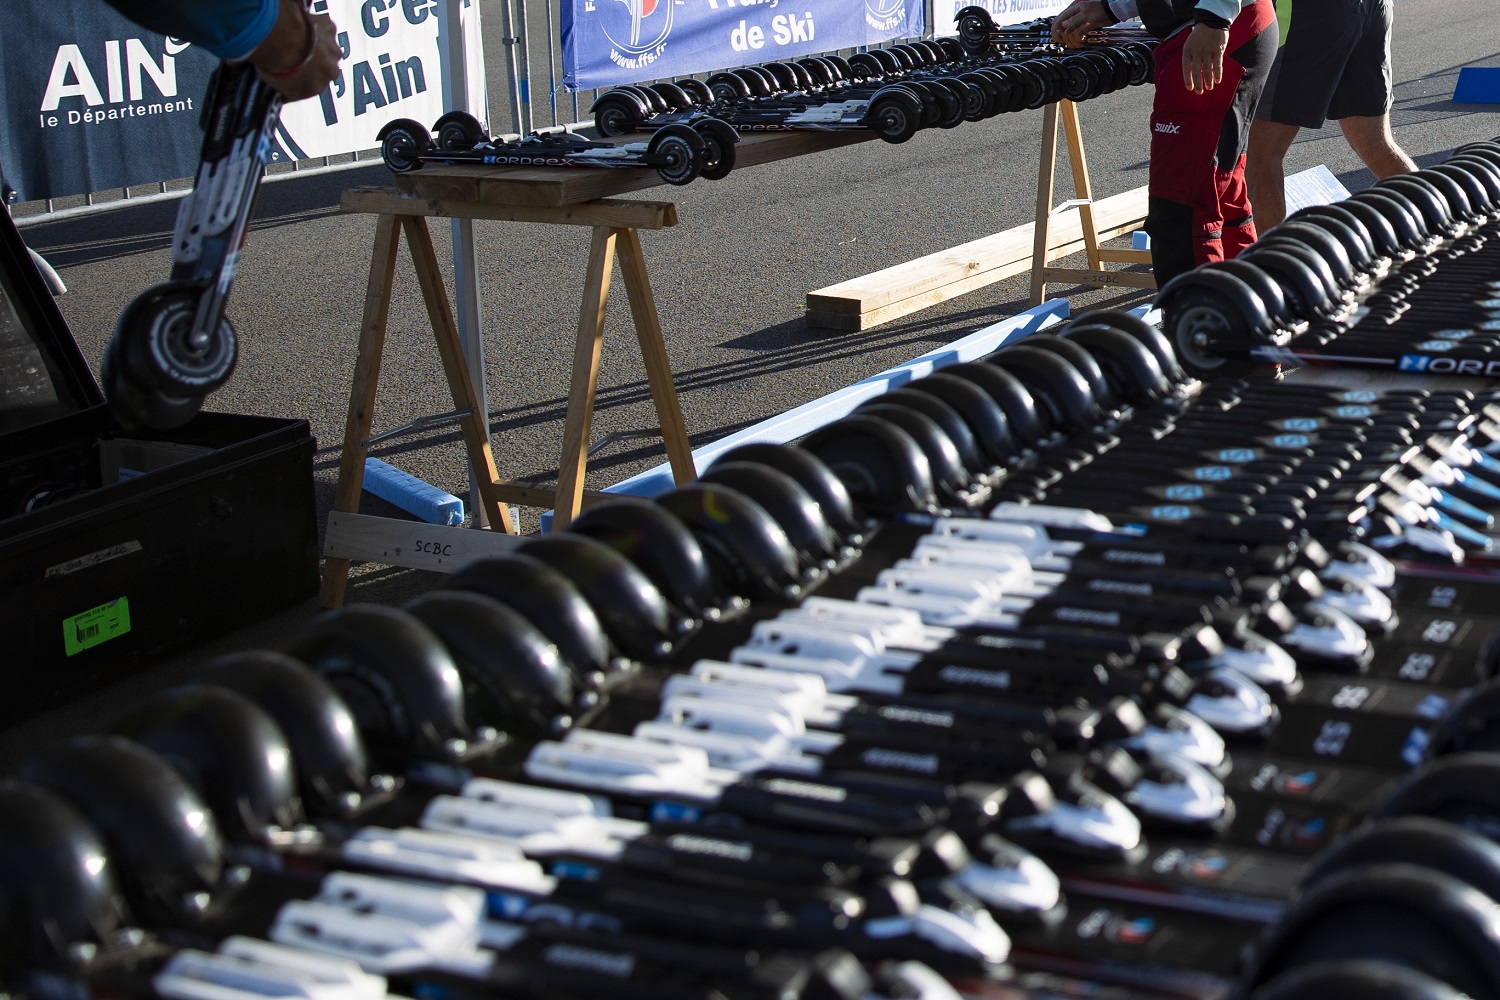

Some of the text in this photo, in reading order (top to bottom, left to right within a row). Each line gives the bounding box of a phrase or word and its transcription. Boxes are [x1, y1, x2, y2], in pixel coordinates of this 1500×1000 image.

[730, 11, 815, 52] de Ski
[866, 7, 906, 31] www.ffs.fr
[609, 42, 667, 69] www.ffs.fr
[40, 38, 178, 111] AIN
[40, 114, 58, 128] le
[68, 97, 194, 125] Département
[1092, 275, 1119, 284] SCBC
[415, 540, 452, 557] SCBC
